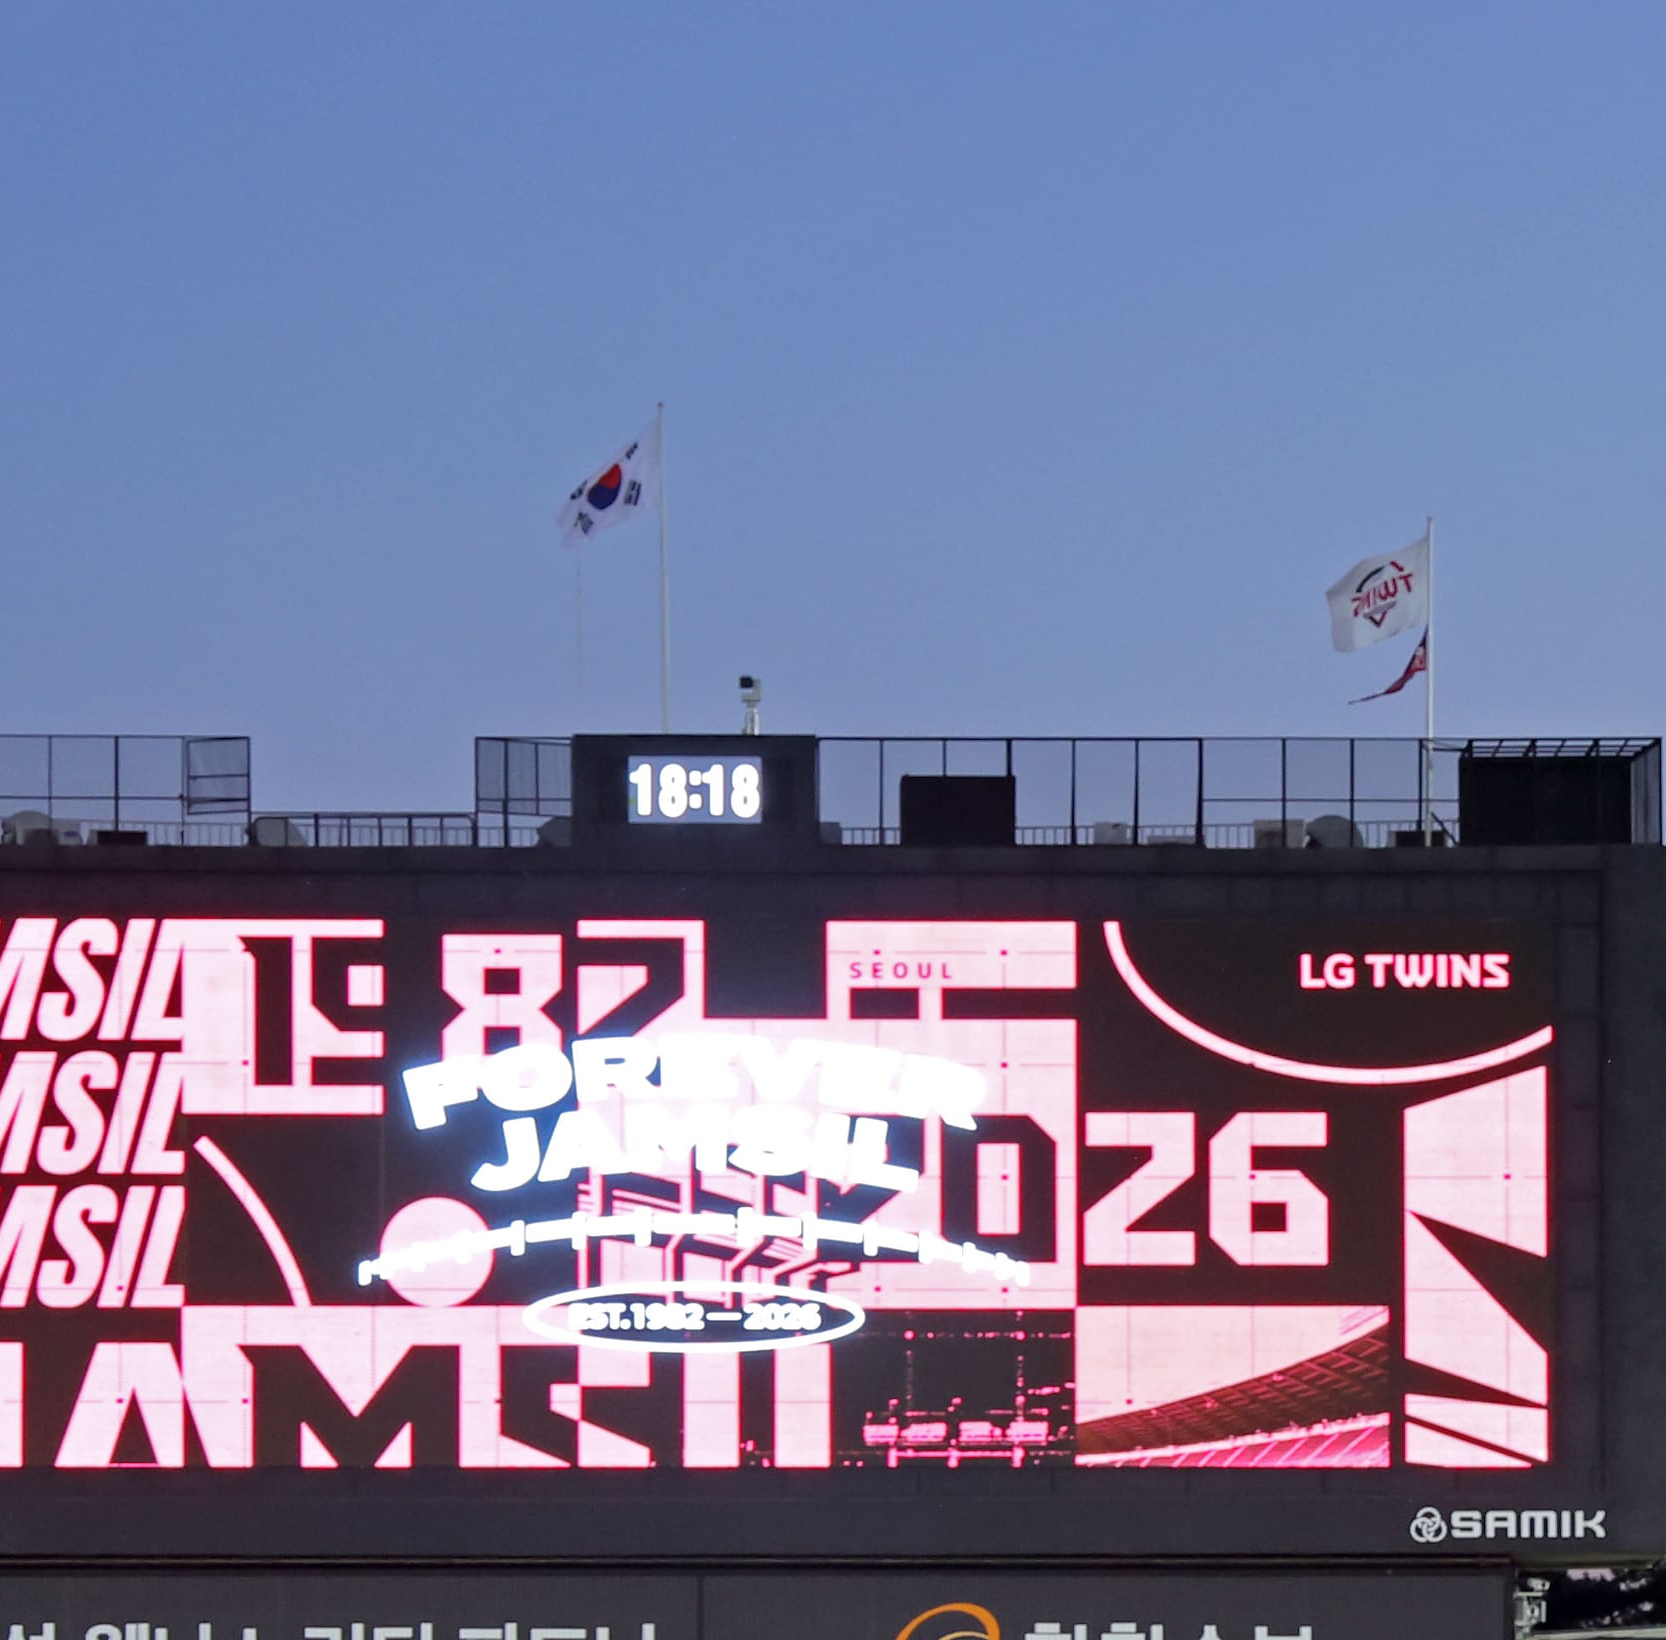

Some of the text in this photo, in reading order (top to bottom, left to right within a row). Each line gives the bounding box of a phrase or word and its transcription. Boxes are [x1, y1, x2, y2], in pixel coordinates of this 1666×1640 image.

[629, 763, 761, 819] 18:18
[850, 962, 954, 980] SEOUL
[1299, 953, 1510, 989] LG TWINS
[402, 1033, 987, 1131] FOREVER
[470, 1104, 920, 1194] JAMSIL
[743, 1303, 822, 1331] 2026
[1451, 1510, 1608, 1540] SAMIK
